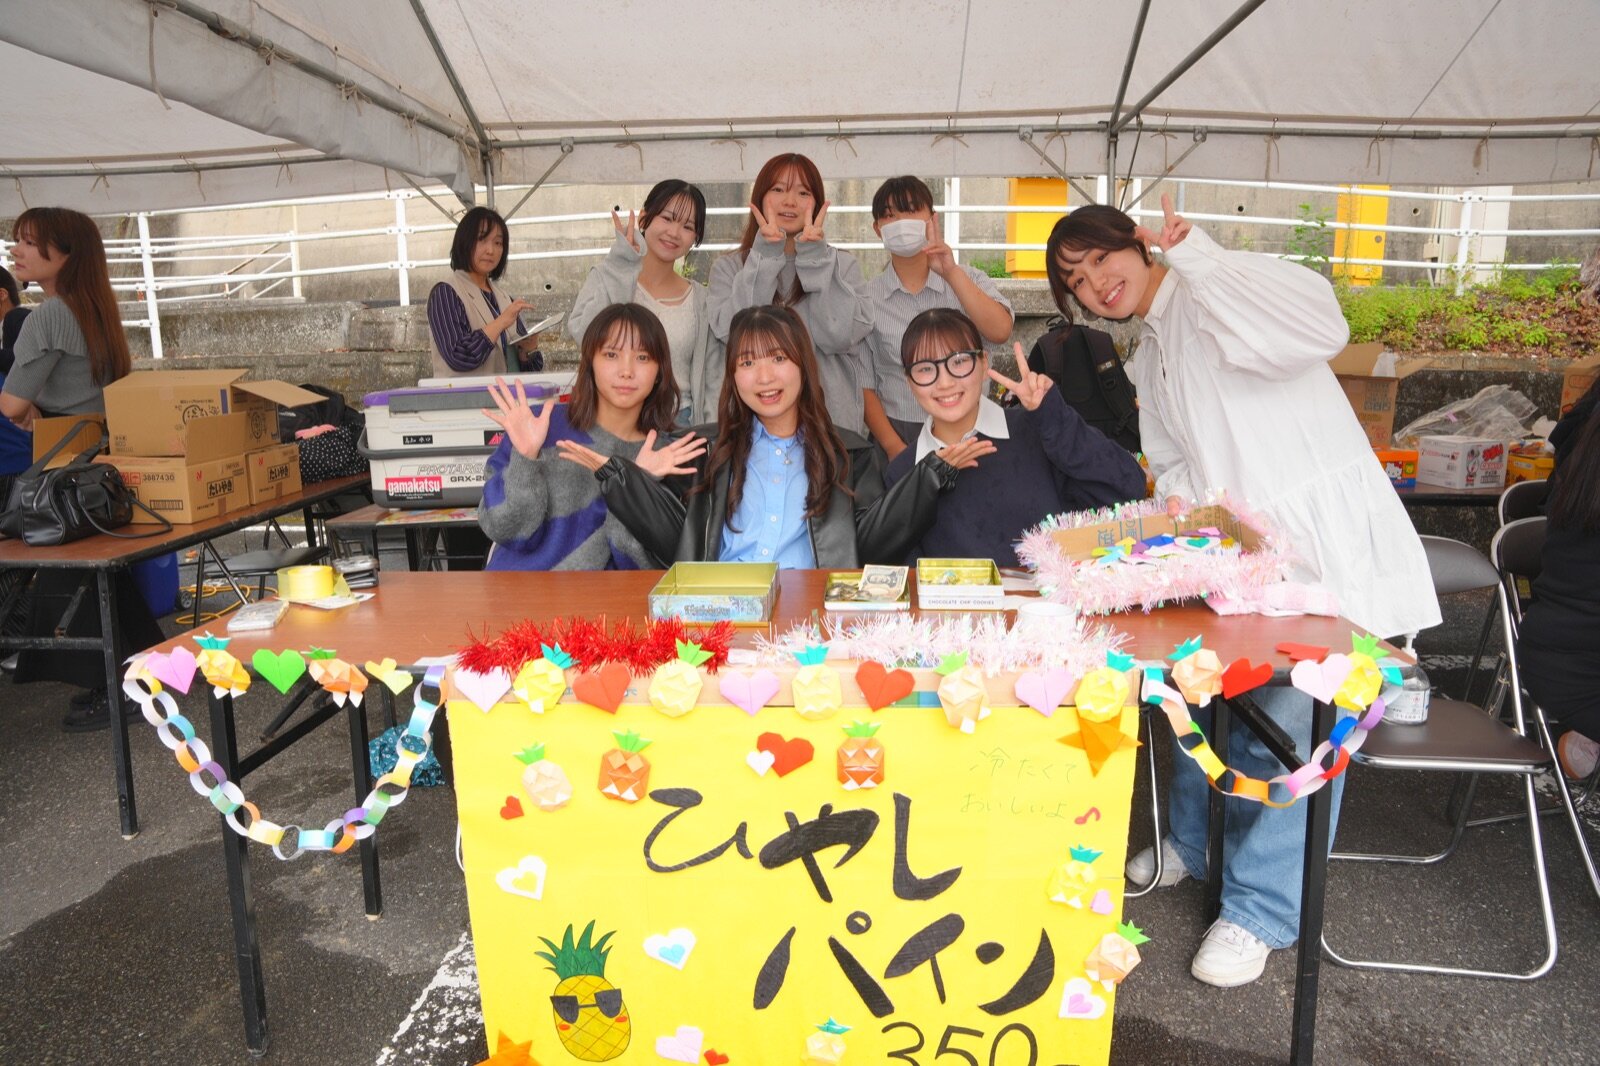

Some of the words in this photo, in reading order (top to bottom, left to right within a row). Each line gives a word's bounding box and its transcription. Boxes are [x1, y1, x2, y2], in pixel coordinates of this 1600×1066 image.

[269, 465, 289, 480] たいやき
[417, 463, 487, 475] PROTARG
[209, 478, 233, 497] たいやき
[388, 478, 440, 496] gamakatsu
[969, 746, 1077, 784] 冷たくて
[960, 792, 1067, 820] おいしいよ
[643, 787, 963, 903] ひやし
[753, 911, 1055, 1018] パイン
[881, 1021, 1080, 1066] 350
